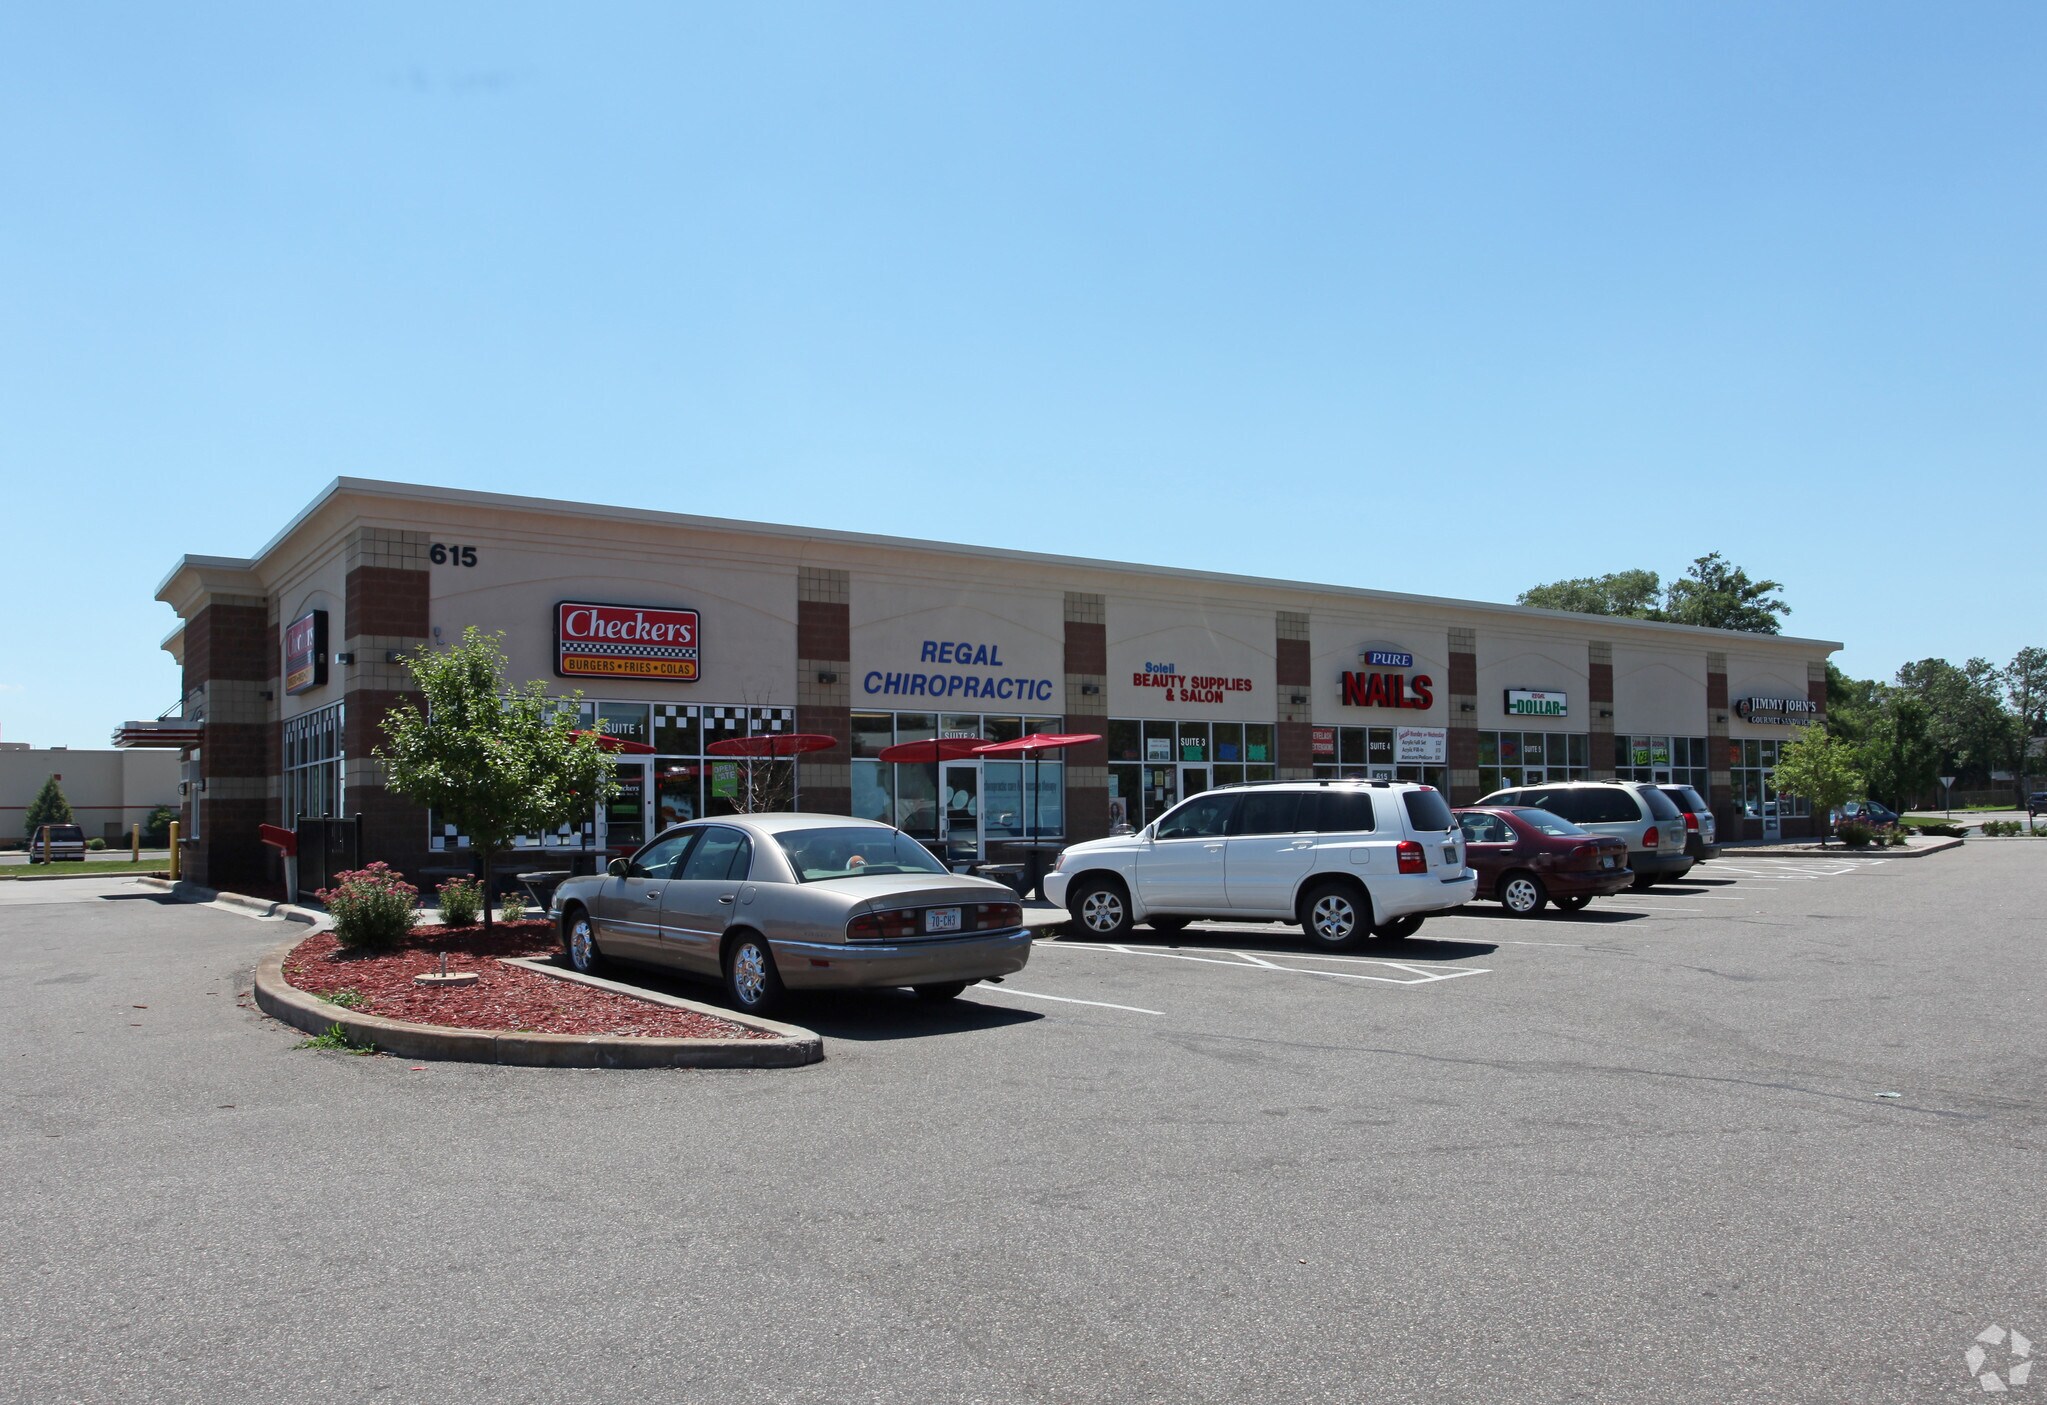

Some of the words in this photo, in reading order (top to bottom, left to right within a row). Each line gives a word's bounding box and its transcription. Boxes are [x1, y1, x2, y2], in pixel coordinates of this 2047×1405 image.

[430, 543, 477, 568] 615
[565, 609, 692, 643] Checkers
[920, 640, 1003, 666] REGAL
[1372, 652, 1410, 666] PURE
[569, 659, 615, 671] BURGERS
[624, 661, 651, 673] FRIES
[660, 663, 690, 675] COLAS
[1145, 661, 1175, 674] Soleil
[863, 671, 1053, 701] CHIROPRACTIC
[1133, 673, 1186, 688] BEAUTY
[1191, 676, 1252, 692] SUPPLIES
[1165, 688, 1175, 702] &
[1180, 689, 1223, 703] SALON
[1342, 670, 1433, 710] NAILS
[1516, 699, 1560, 714] DOLLAR
[1751, 697, 1784, 712] JIMMY
[1785, 700, 1816, 714] JOHN'S
[1751, 716, 1780, 725] GOURMET
[604, 723, 635, 735] SUITE
[639, 724, 644, 735] 1
[944, 731, 968, 739] SUITE
[1312, 731, 1333, 740] EYELASH
[1180, 737, 1200, 747] SUITE
[1201, 738, 1206, 747] 3
[1369, 742, 1386, 750] SUITE
[1386, 742, 1391, 750] 4
[1524, 745, 1538, 753] SUITE
[714, 764, 735, 773] OPEN
[714, 771, 736, 782] LATE
